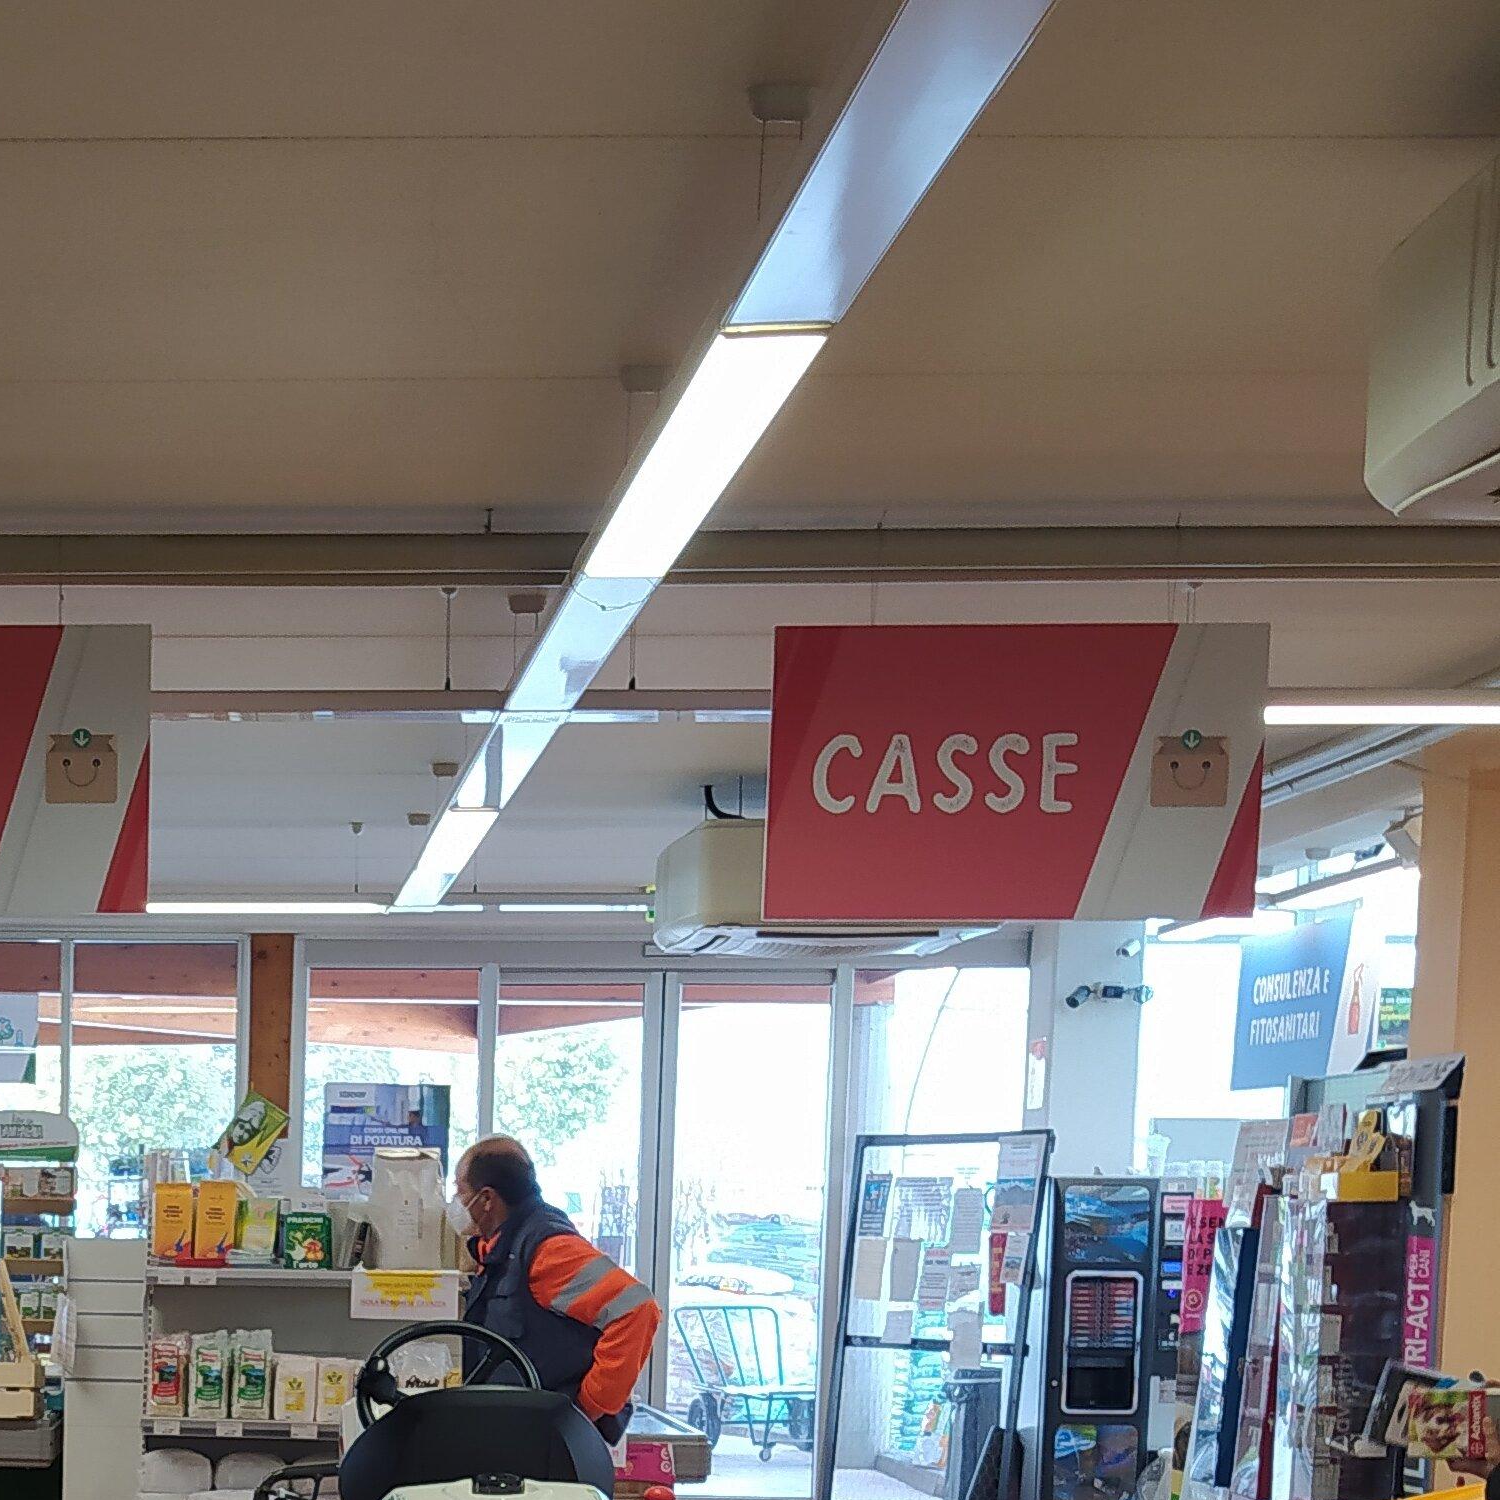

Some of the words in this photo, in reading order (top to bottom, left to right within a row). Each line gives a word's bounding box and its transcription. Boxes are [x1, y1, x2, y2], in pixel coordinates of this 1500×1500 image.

[812, 732, 1079, 814] CASSE
[1253, 965, 1321, 1006] CONSULENZA
[1323, 969, 1330, 994] E
[1250, 1011, 1321, 1046] FITOSANITARI
[350, 1135, 362, 1146] DI
[364, 1135, 423, 1147] POTATURA
